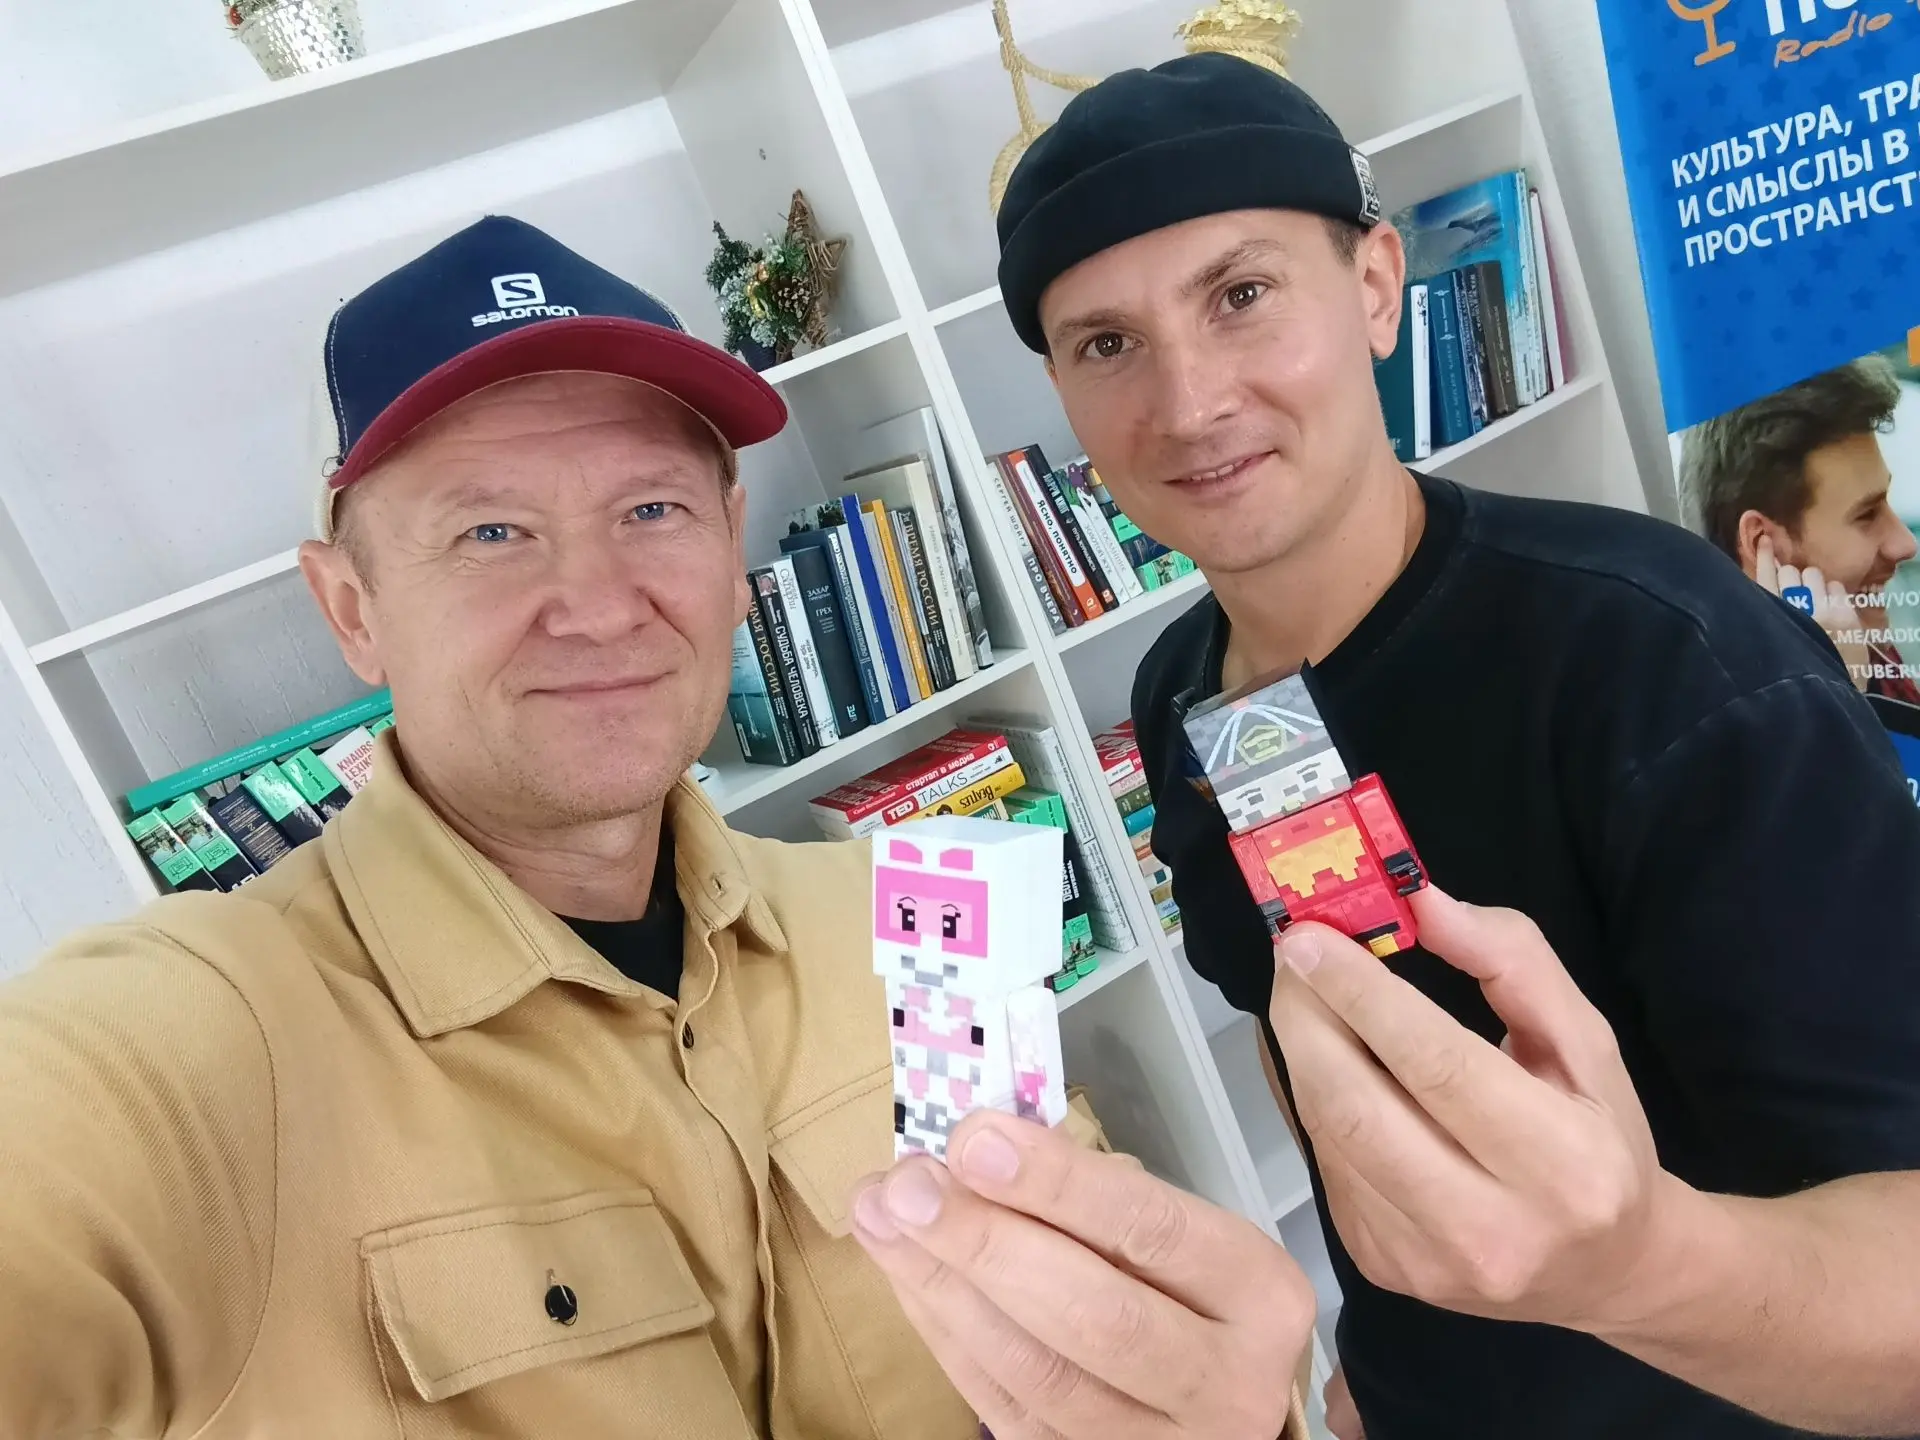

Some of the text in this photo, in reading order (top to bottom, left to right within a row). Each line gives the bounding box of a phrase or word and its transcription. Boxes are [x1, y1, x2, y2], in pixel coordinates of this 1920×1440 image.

[1774, 10, 1893, 69] Radio
[1672, 104, 1853, 187] КУЛЬТУРА,
[1678, 129, 1909, 228] И СМЫСЛЫ В
[1684, 171, 1920, 268] ПРОСТРАНСТ
[806, 585, 830, 598] ЗАХАР
[905, 525, 922, 568] ВРЕМЯ
[917, 571, 939, 626] РОССИИ
[1027, 557, 1061, 625] ПРО ВЧЕРА
[815, 607, 833, 618] ГРЕХ
[757, 637, 781, 695] РОССИИ
[775, 626, 794, 664] СУДЬБА
[787, 665, 809, 719] ЧЕЛОВЕКА
[1847, 664, 1920, 679] TUBE.RU
[337, 741, 373, 771] KNAURS
[905, 770, 939, 791] стартап
[940, 766, 947, 775] в
[948, 753, 975, 769] медиа
[887, 800, 914, 821] TED
[918, 772, 968, 805] TALKS
